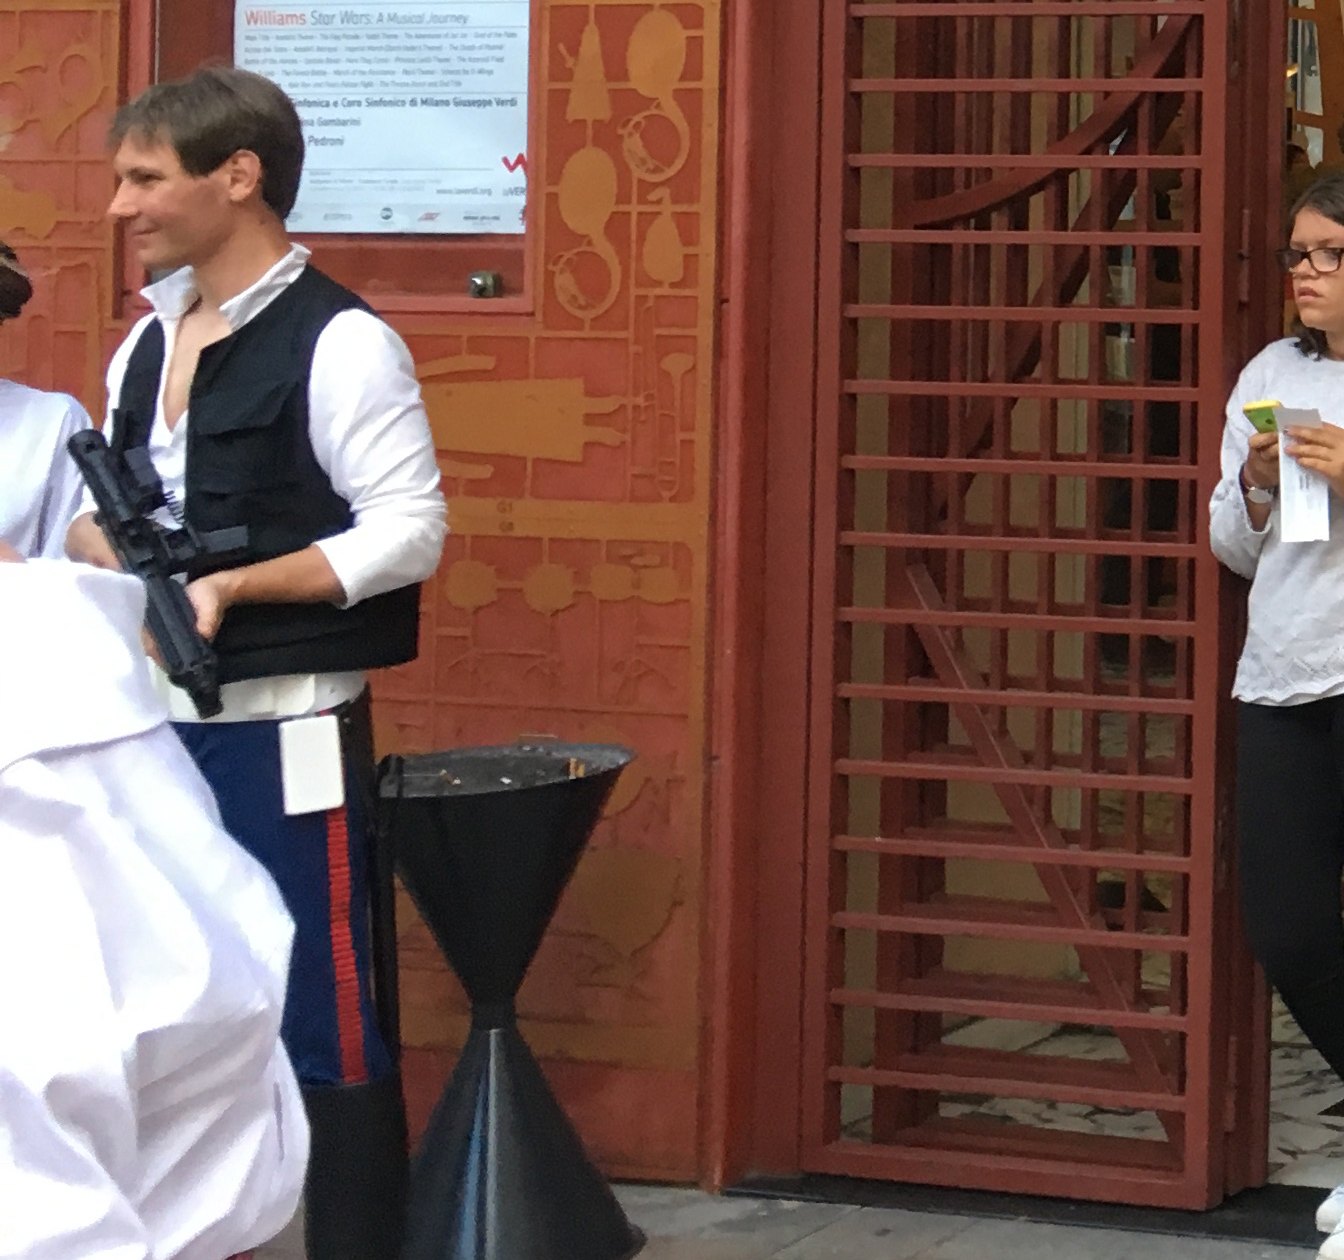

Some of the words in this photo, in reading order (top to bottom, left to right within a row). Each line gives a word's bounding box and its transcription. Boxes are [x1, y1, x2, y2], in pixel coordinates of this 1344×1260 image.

[245, 10, 307, 27] Williams
[311, 9, 335, 26] Star
[376, 14, 385, 25] A
[387, 12, 425, 25] Musical
[426, 12, 470, 25] Journey
[341, 97, 362, 108] Coro
[365, 97, 407, 108] Sinfonico
[409, 97, 418, 107] di
[420, 96, 451, 108] Milano
[452, 96, 493, 109] Giuseppe
[495, 96, 518, 108] Verdi
[308, 135, 345, 147] Pedroni
